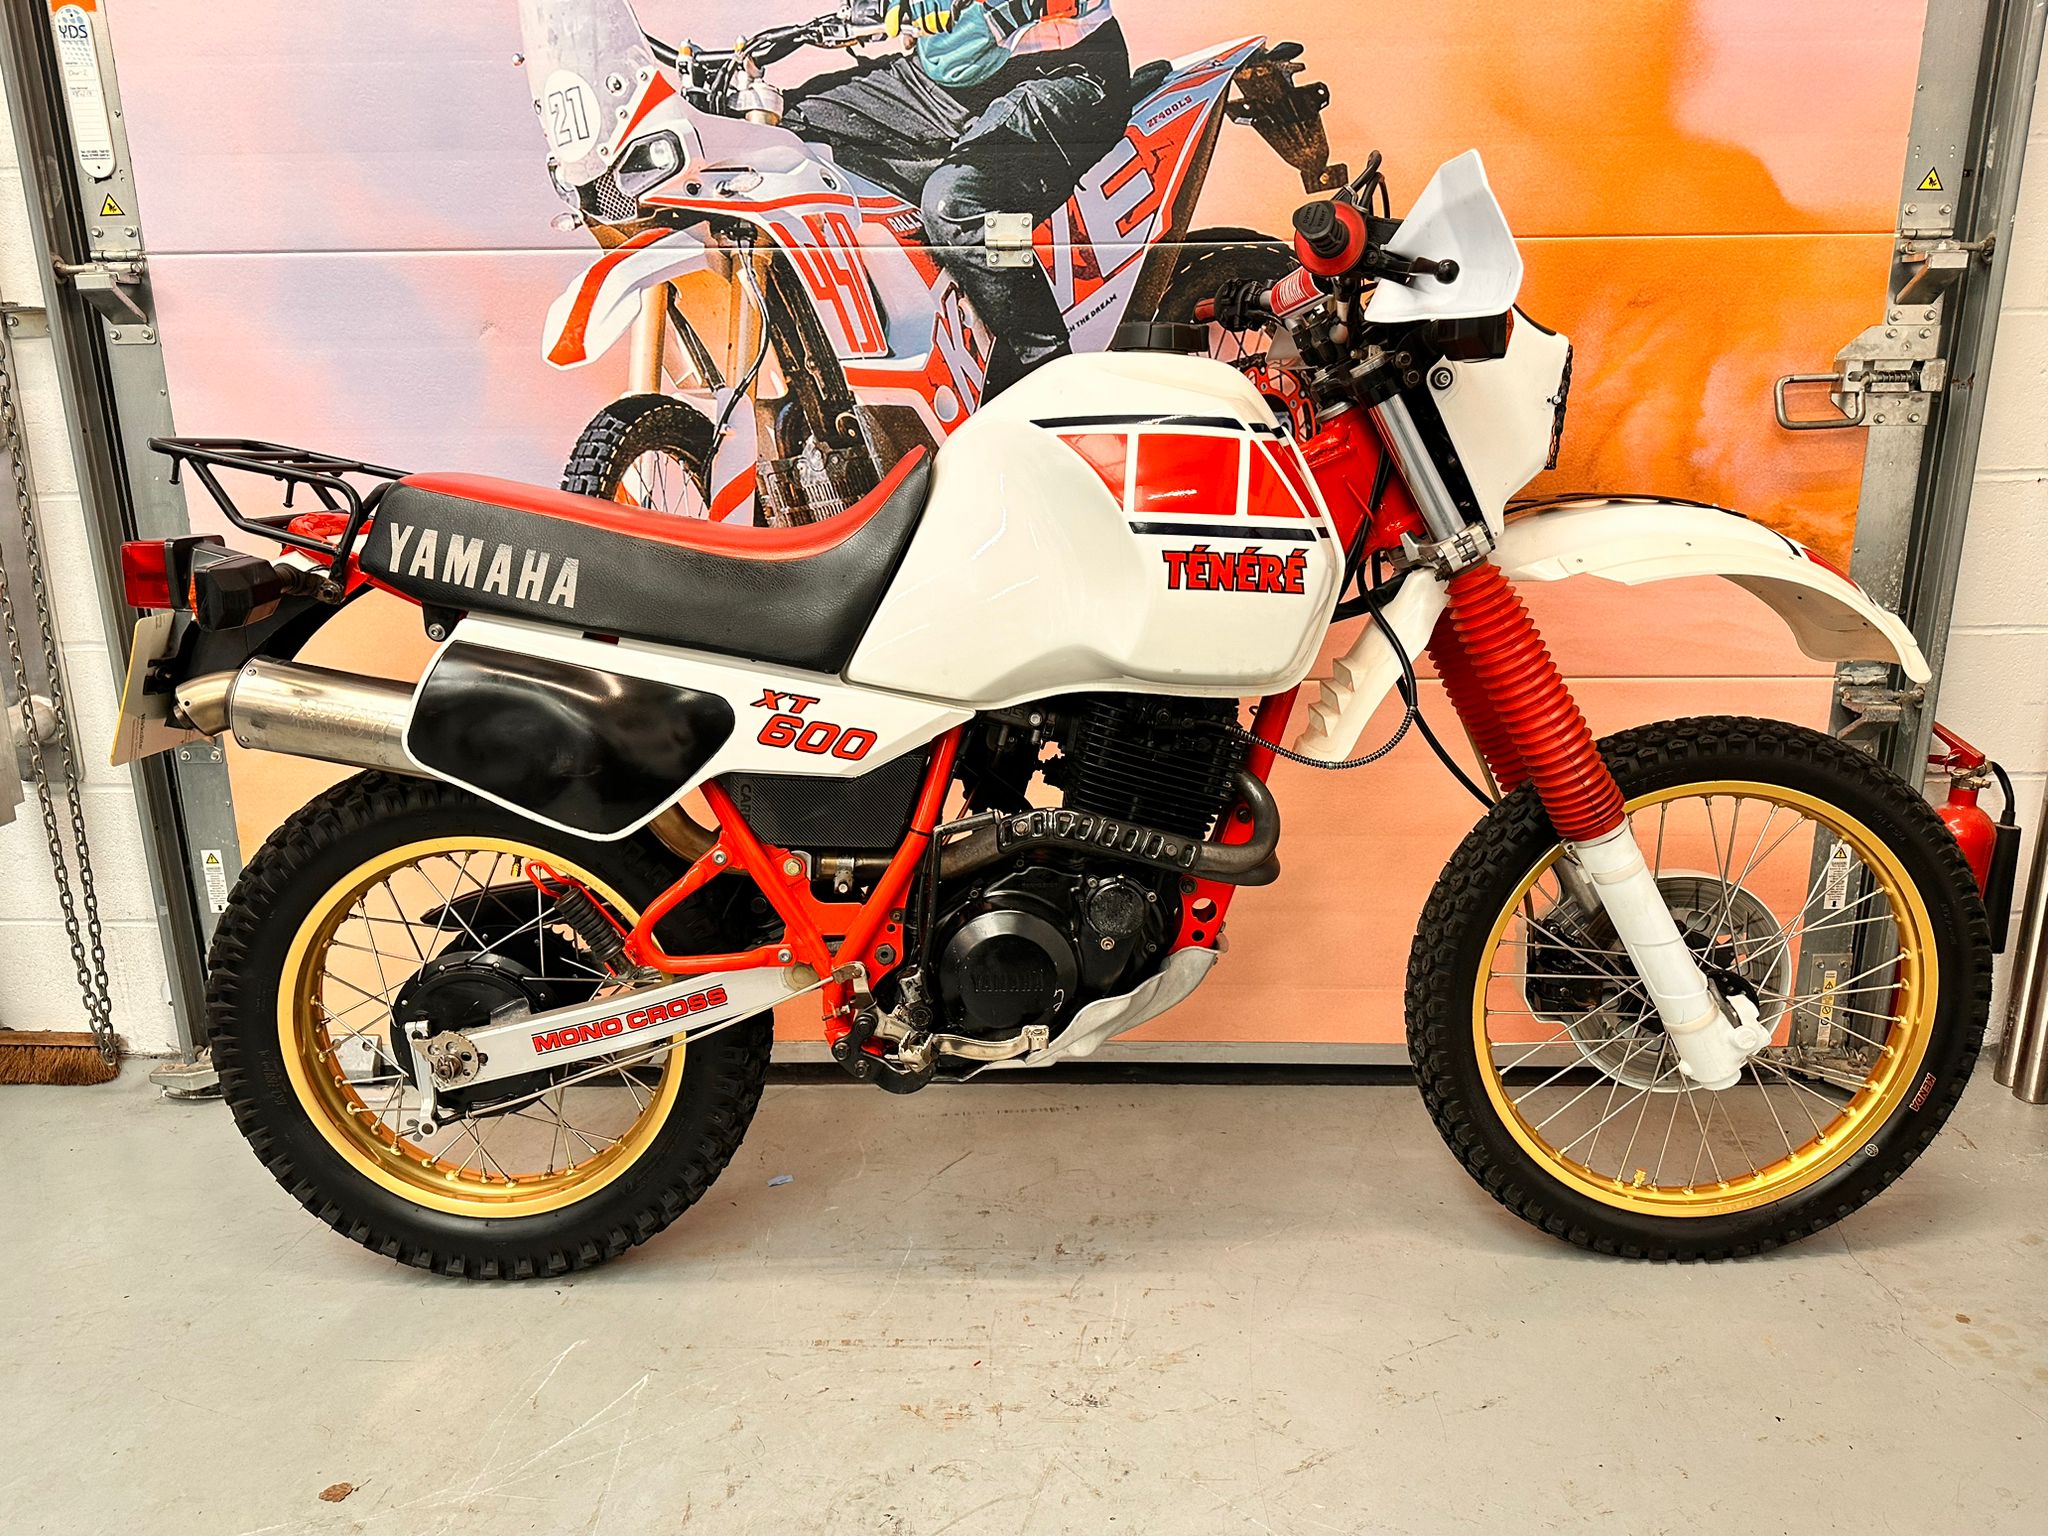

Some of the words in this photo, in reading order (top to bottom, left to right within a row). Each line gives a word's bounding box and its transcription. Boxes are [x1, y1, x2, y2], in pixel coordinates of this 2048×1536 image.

[58, 24, 88, 39] YDS
[548, 85, 590, 147] 21
[1075, 313, 1090, 328] THE
[1090, 292, 1118, 318] DREAM
[389, 522, 580, 609] YAMAHA
[1161, 544, 1310, 595] TÉNÉRÉ
[750, 688, 821, 714] XT
[756, 713, 878, 761] 600
[531, 1017, 624, 1053] MONO
[625, 986, 729, 1030] CROSS
[1908, 1071, 1937, 1113] KENDA
